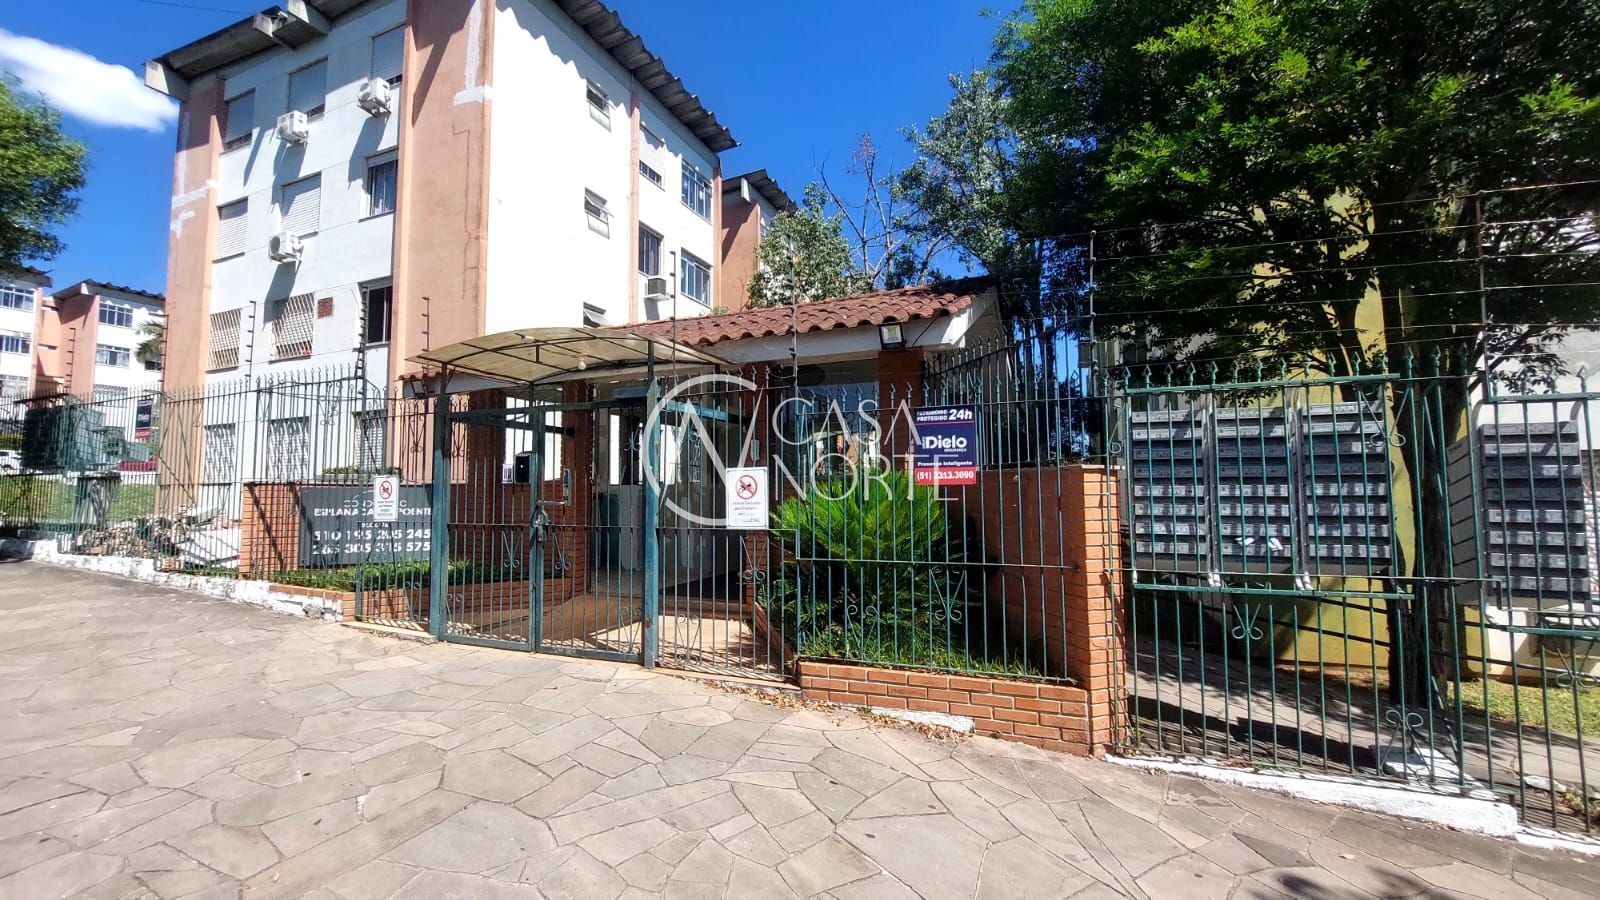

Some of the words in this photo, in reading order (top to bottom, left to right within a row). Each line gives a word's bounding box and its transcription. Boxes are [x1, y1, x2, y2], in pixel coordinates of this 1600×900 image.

[948, 408, 973, 421] 24h
[925, 434, 968, 449] Dielo
[917, 471, 932, 481] (51)
[406, 528, 431, 539] 245
[405, 541, 431, 552] 575
